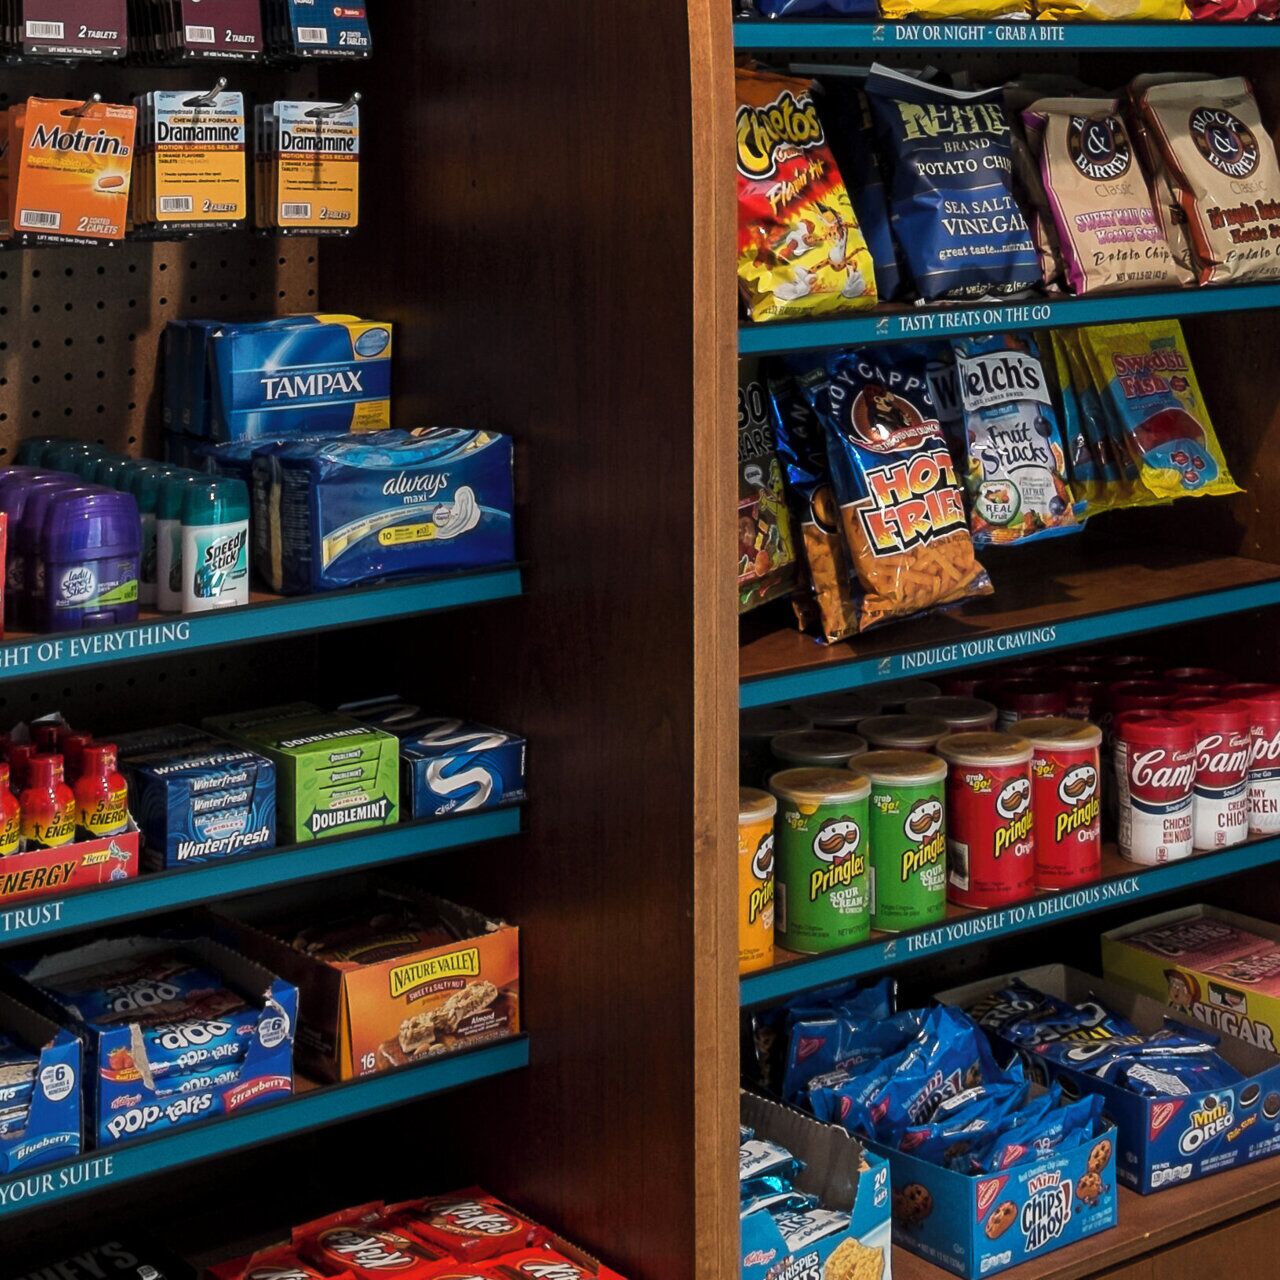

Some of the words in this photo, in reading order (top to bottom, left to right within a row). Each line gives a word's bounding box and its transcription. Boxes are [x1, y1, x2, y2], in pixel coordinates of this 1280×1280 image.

[896, 25, 920, 41] DAY
[923, 25, 942, 40] OR
[945, 25, 985, 41] NIGHT
[995, 25, 1027, 41] GRAB
[1029, 25, 1037, 41] A
[1040, 25, 1064, 41] BITE
[30, 123, 121, 155] Motrin
[158, 121, 240, 142] Dramamine
[281, 130, 355, 151] Dramamine
[944, 137, 990, 153] BRAND
[916, 159, 977, 176] POTATO
[945, 199, 969, 215] SEA
[972, 197, 1009, 214] SALT
[87, 224, 118, 234] CAPLETS
[899, 315, 934, 332] TASTY
[937, 311, 981, 328] TREATS
[983, 309, 1005, 325] ON
[1006, 306, 1030, 323] THE
[1032, 305, 1051, 321] GO
[1112, 349, 1188, 376] Swedish
[261, 370, 363, 400] TAMPAX
[1121, 376, 1169, 398] Fish
[989, 422, 1031, 448] Fruit
[981, 443, 1049, 475] Snacks
[383, 470, 448, 499] always
[869, 453, 957, 512] HOT
[404, 494, 427, 505] maxi
[986, 504, 1012, 514] REAL
[865, 491, 965, 546] FRIES
[37, 641, 64, 661] OF
[69, 621, 191, 657] EVERYTHING
[901, 644, 956, 670] INDULGE
[959, 636, 995, 658] YOUR
[997, 626, 1056, 650] CRAVINGS
[312, 800, 387, 832] DOUBLEMINT
[177, 827, 270, 861] Winterfresh
[810, 852, 865, 900] Pringles
[830, 887, 859, 901] SOUR
[832, 895, 863, 908] CREAM
[1, 902, 64, 928] TRUST
[906, 928, 943, 953] TREAT
[946, 914, 1006, 942] YOURSELF
[1008, 909, 1026, 926] TO
[1026, 906, 1038, 921] A
[1038, 890, 1100, 916] DELICIOUS
[1101, 877, 1140, 899] SNACK
[393, 961, 437, 989] NATURE
[438, 951, 476, 976] VALLEY
[471, 1011, 495, 1025] Almond
[1194, 1003, 1275, 1050] SUGAR
[229, 1078, 285, 1108] Strawberry
[17, 1133, 71, 1160] Blueberry
[1180, 1114, 1234, 1153] OREO
[59, 1156, 114, 1188] SUITE
[1021, 1187, 1064, 1230] Chips
